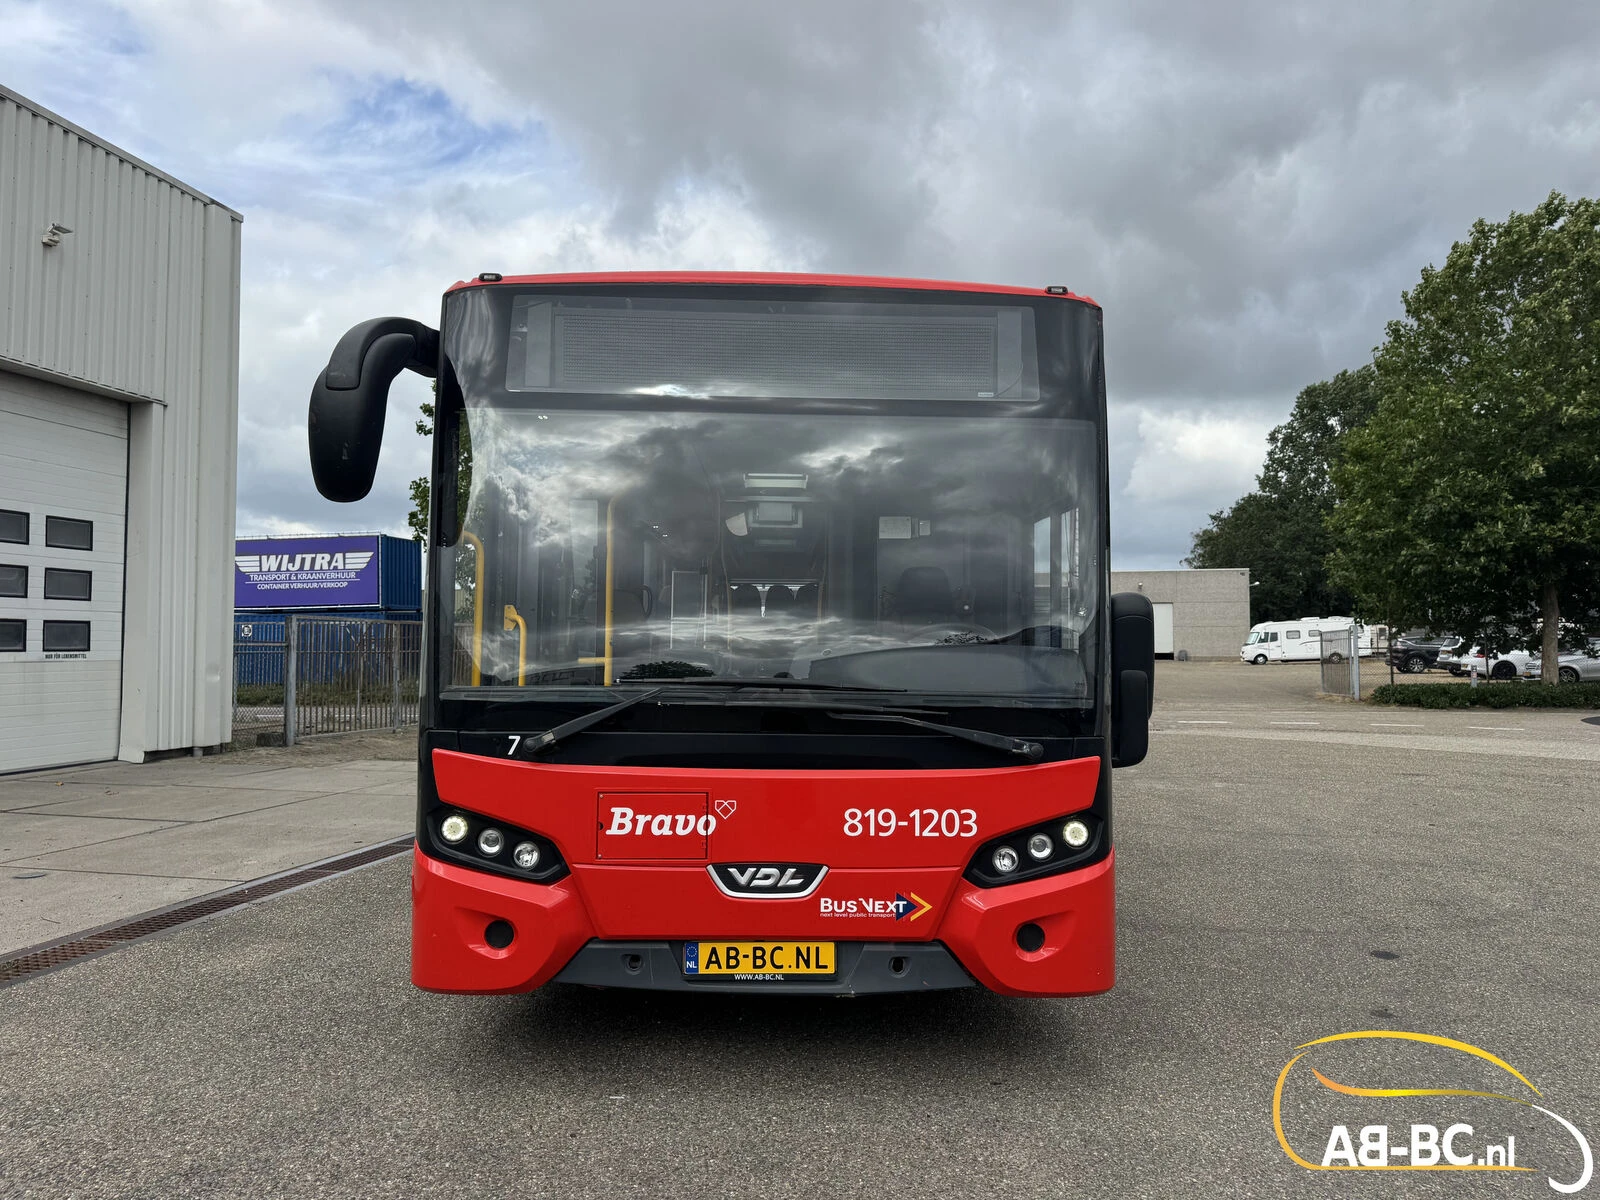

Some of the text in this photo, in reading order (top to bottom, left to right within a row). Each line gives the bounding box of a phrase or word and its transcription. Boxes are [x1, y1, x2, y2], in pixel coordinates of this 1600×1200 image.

[261, 553, 345, 571] WIJTRA
[249, 573, 290, 581] TRANSPORT
[298, 571, 356, 580] KRAANVERHUUR
[290, 581, 348, 589] VERHUUR/VERKOOP
[508, 735, 521, 755] 7
[606, 807, 717, 836] Bravo
[843, 807, 978, 837] 819-1203
[727, 867, 804, 887] VDL
[686, 961, 697, 969] NL
[705, 946, 829, 970] AB-BC.NL
